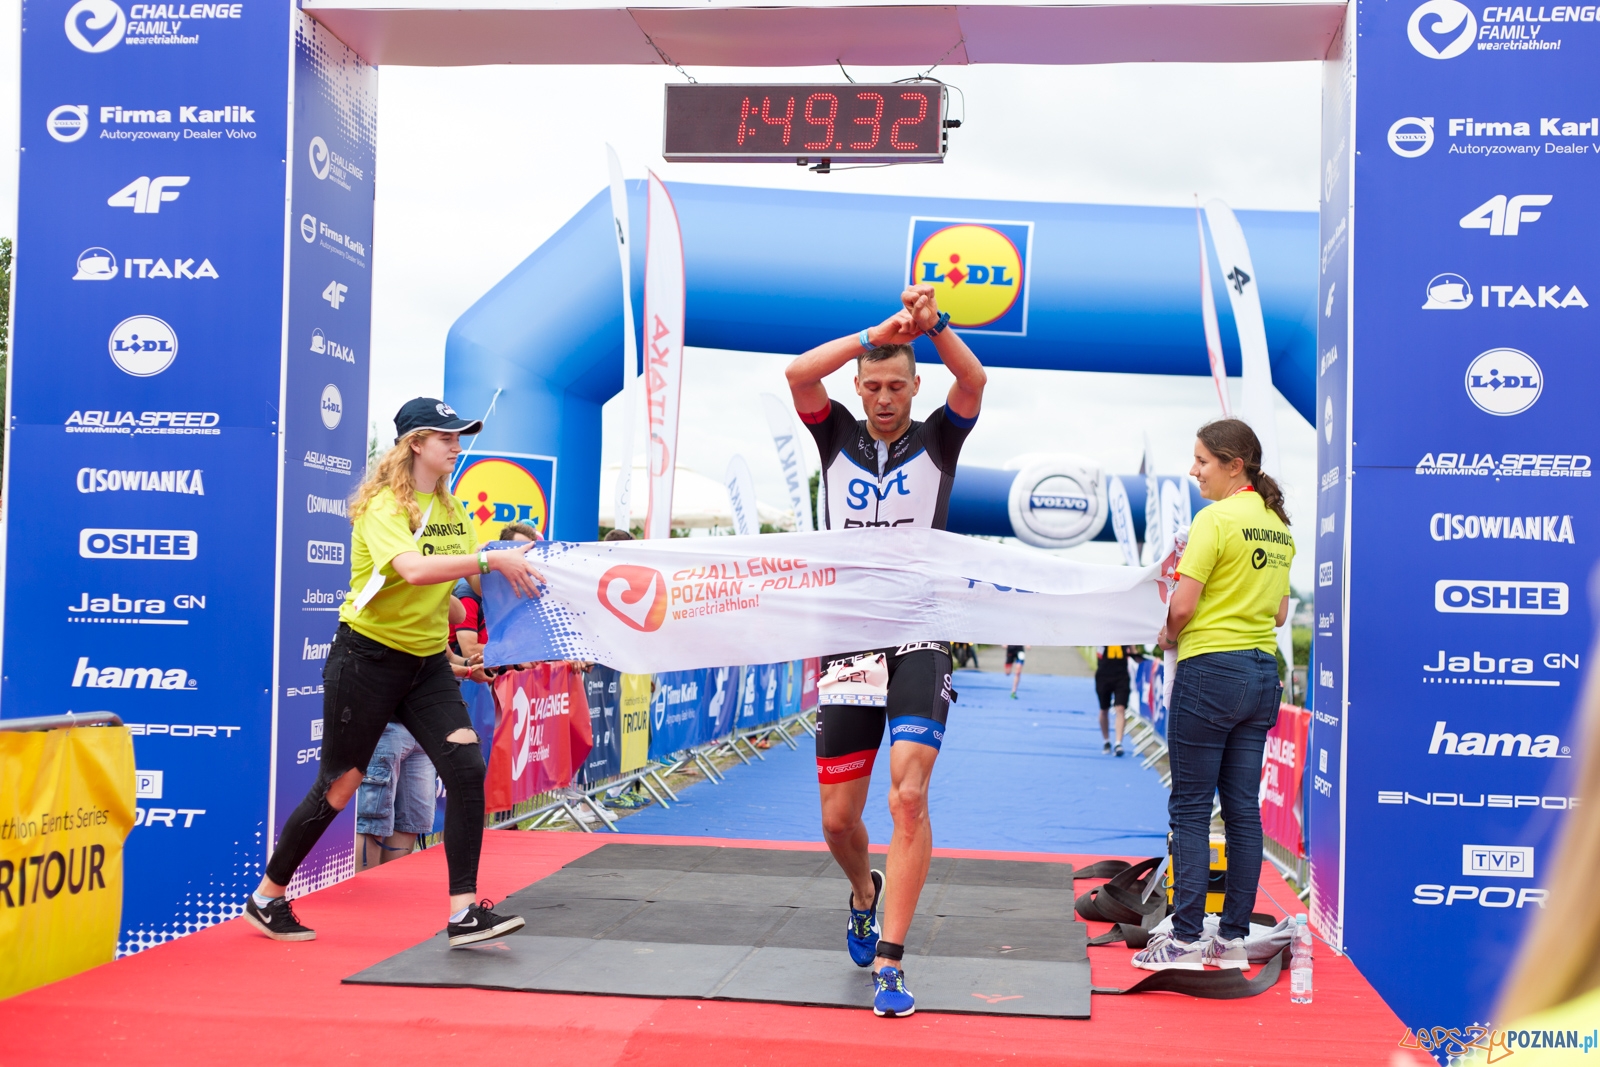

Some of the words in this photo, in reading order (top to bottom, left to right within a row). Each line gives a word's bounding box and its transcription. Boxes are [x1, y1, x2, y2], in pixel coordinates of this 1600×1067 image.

[130, 4, 243, 19] CHALLENGE
[1482, 6, 1600, 22] CHALLENG
[127, 21, 181, 35] FAMILY
[1478, 25, 1541, 40] FAMILY
[1477, 40, 1561, 50] wearetriathlon!
[100, 106, 171, 123] Firma
[179, 106, 256, 123] Karlik
[737, 92, 928, 150] 1:49.32
[100, 129, 181, 142] Autoryzowany
[183, 129, 222, 140] Dealer
[225, 129, 257, 140] Volvo
[1449, 118, 1530, 136] Firma
[1448, 143, 1541, 156] Autoryzowany
[1545, 142, 1589, 154] Dealer
[330, 152, 364, 180] CHALLENGE
[107, 176, 191, 214] 4F
[1459, 194, 1553, 236] 4F
[320, 222, 342, 244] Firma
[344, 234, 366, 257] Karlik
[124, 258, 219, 280] ITAKA
[322, 280, 348, 310] 4F
[1481, 285, 1589, 310] ITAKA
[327, 340, 356, 364] ITAKA
[76, 468, 205, 496] CISOWIANKA
[1415, 468, 1488, 476] SWIMMING
[1492, 469, 1592, 478] ACCESSORIES
[307, 494, 347, 518] CISOWIANKA
[1032, 496, 1087, 510] VOLVO
[1430, 512, 1575, 544] CISOWIANKA
[87, 534, 190, 556] OSHEE
[310, 544, 342, 562] OSHEE
[761, 567, 836, 592] POLAND
[68, 593, 166, 614] Jabra
[173, 595, 206, 610] GN
[303, 589, 334, 604] Jabra
[672, 594, 760, 620] wearetriathlon!
[1442, 586, 1561, 610] OSHEE
[302, 637, 332, 660] ham
[1423, 650, 1534, 674] Jabra
[1543, 653, 1580, 670] GN
[1378, 790, 1583, 810] ENDUSPOR
[41, 811, 74, 835] Eents
[76, 805, 110, 828] Series
[1475, 854, 1520, 868] TVP
[1412, 884, 1550, 908] SPOR
